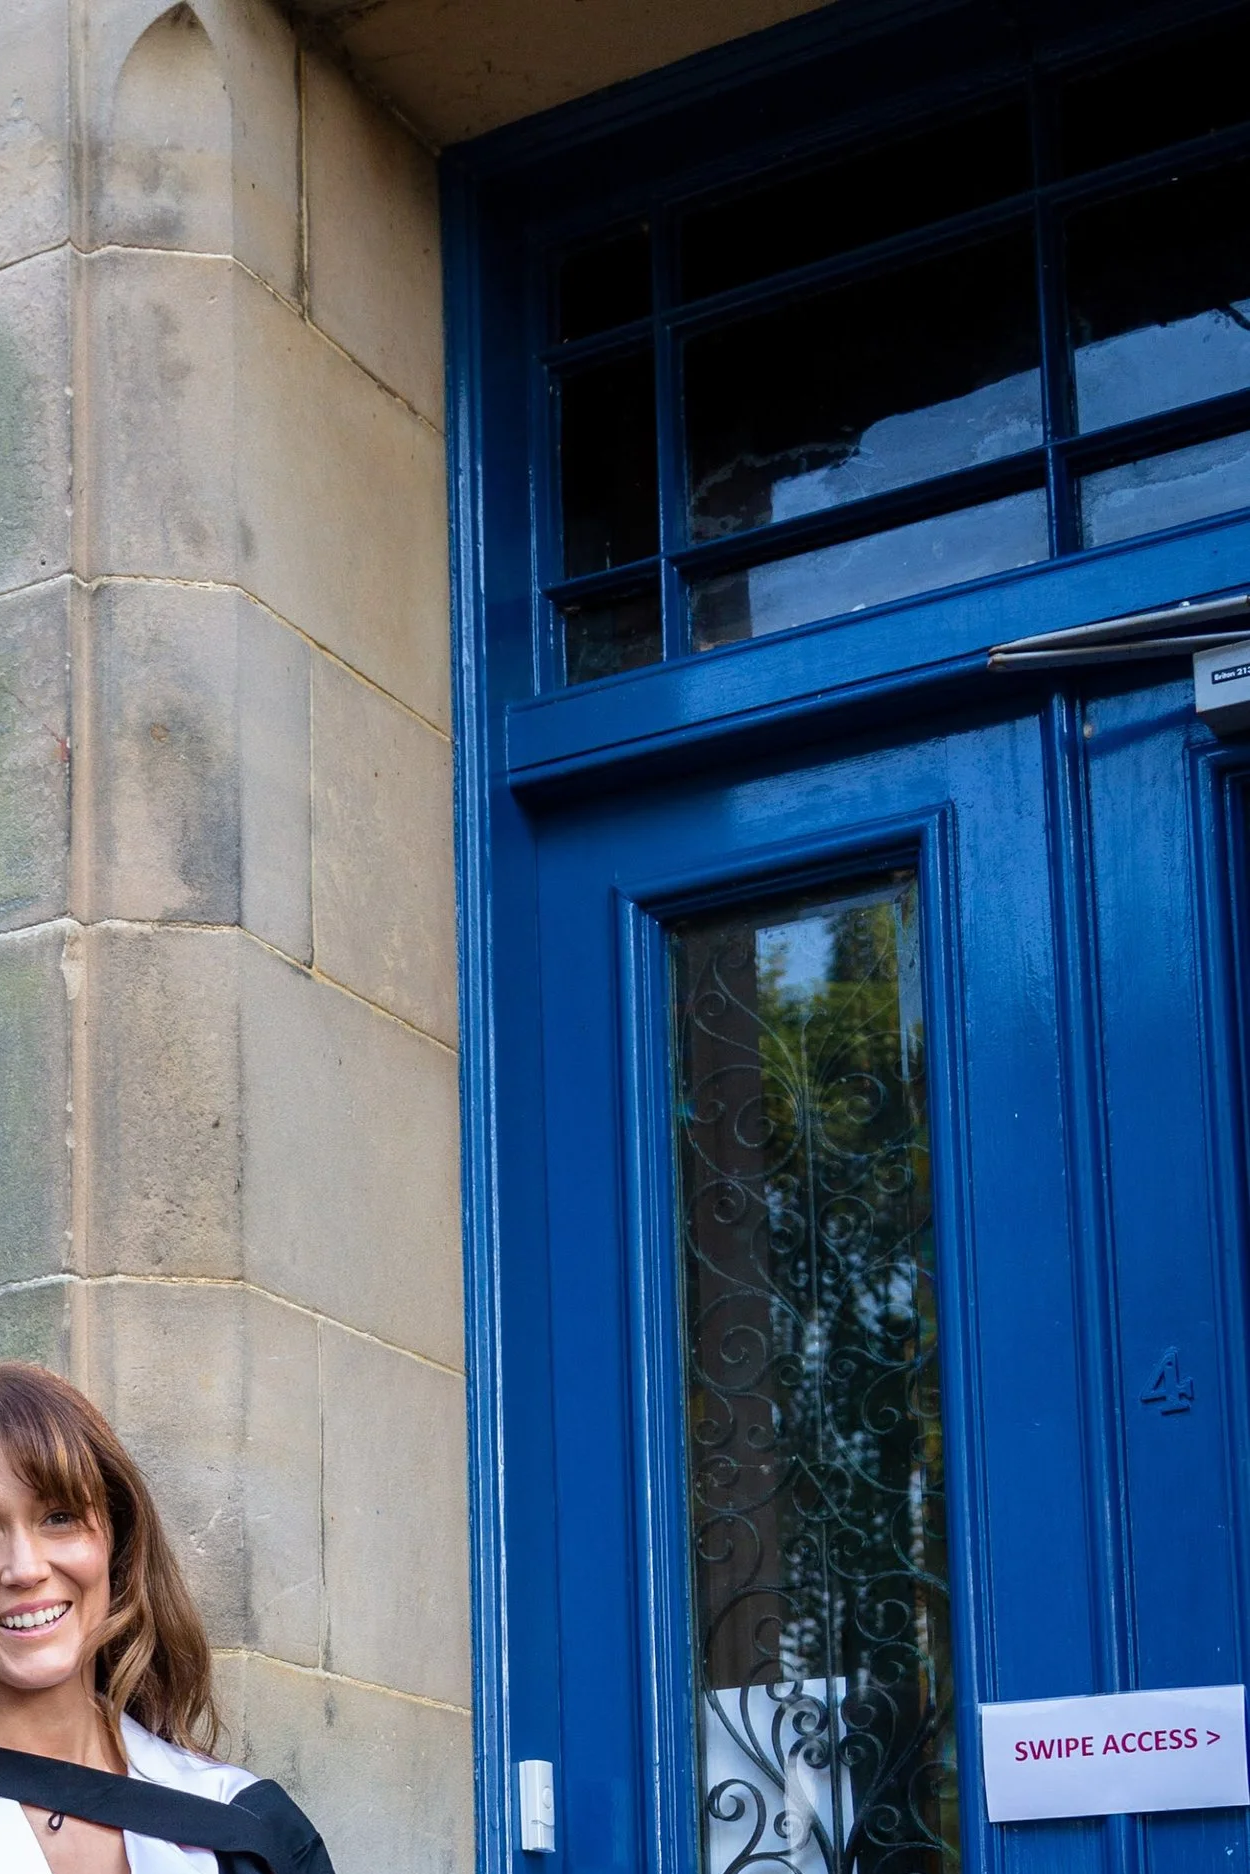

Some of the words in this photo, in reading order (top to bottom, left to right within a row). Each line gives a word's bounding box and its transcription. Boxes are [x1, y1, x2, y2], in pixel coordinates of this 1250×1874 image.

[1139, 1345, 1195, 1416] 4
[1014, 1736, 1094, 1761] SWIPE
[1102, 1727, 1198, 1755] ACCESS
